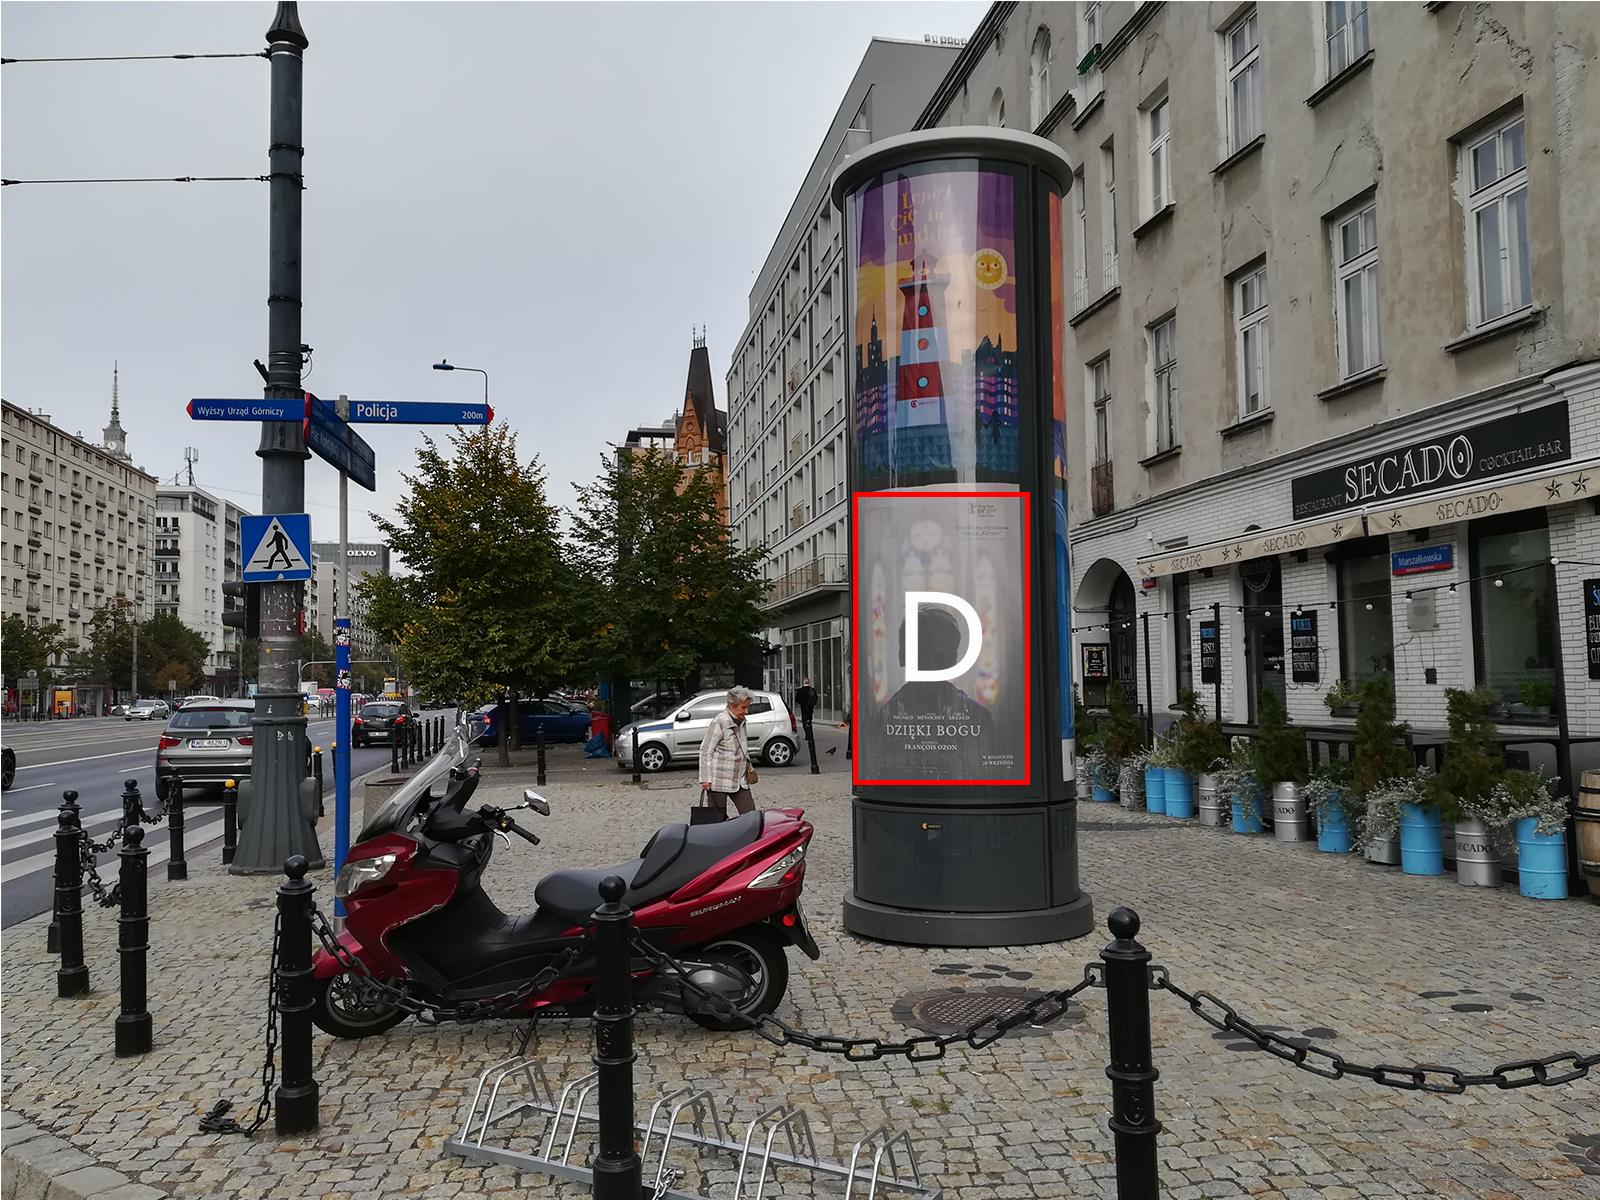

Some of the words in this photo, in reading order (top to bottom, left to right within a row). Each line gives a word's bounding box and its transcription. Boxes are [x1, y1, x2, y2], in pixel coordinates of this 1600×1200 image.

[197, 406, 225, 417] Wyższy
[227, 406, 249, 417] Urząd
[251, 406, 284, 417] Górniczy
[357, 403, 398, 421] Policja
[462, 411, 483, 420] 200m
[1345, 435, 1474, 503] SECADO
[1479, 449, 1536, 472] COCKTAIL
[1538, 439, 1563, 459] BAR
[886, 724, 931, 740] DZIĘKI
[936, 724, 981, 737] BOGU
[904, 744, 937, 752] FRANÇOIS
